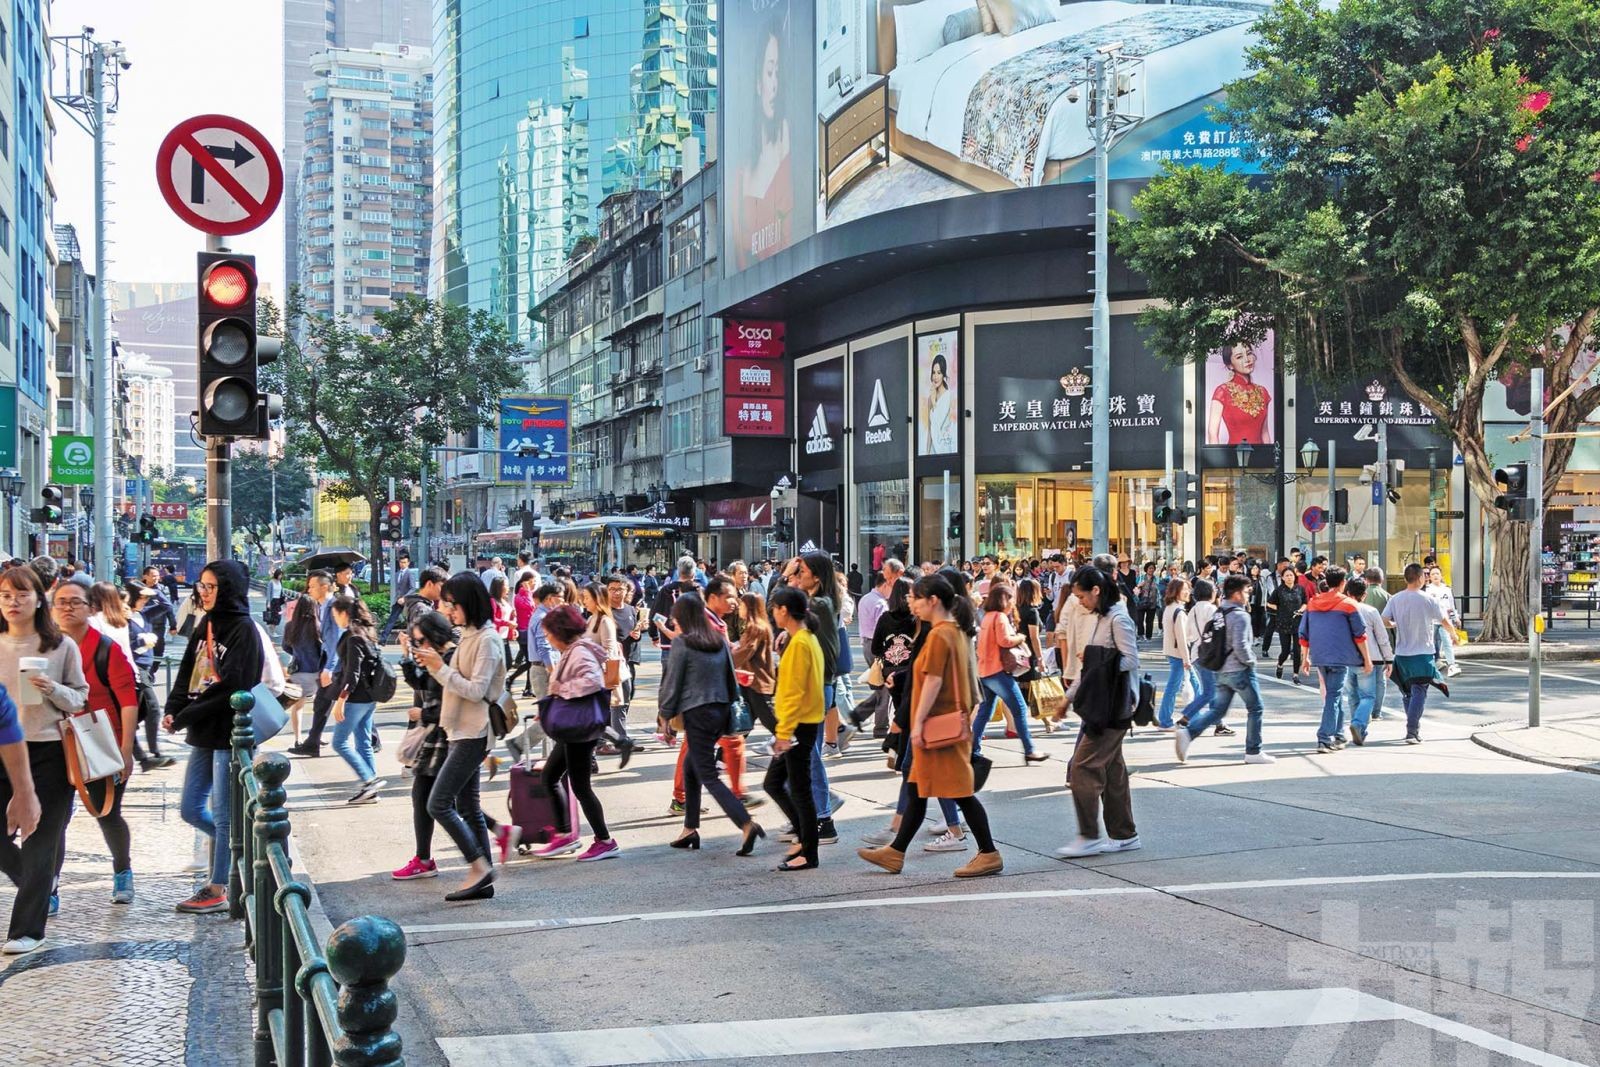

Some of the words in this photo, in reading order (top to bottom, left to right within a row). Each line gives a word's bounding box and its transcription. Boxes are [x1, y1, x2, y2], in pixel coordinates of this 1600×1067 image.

[738, 410, 772, 422] 特賣場
[1314, 416, 1349, 424] EMPEROR
[1351, 416, 1377, 424] WATCH
[1393, 417, 1437, 425] JEWELLERY
[992, 421, 1039, 432] EMPEROR
[1041, 420, 1077, 431] WATCH
[1079, 419, 1093, 429] AN
[1108, 416, 1162, 428] EWELLERY
[865, 427, 893, 444] Reebok
[805, 435, 834, 454] adidas
[58, 465, 95, 475] bossin
